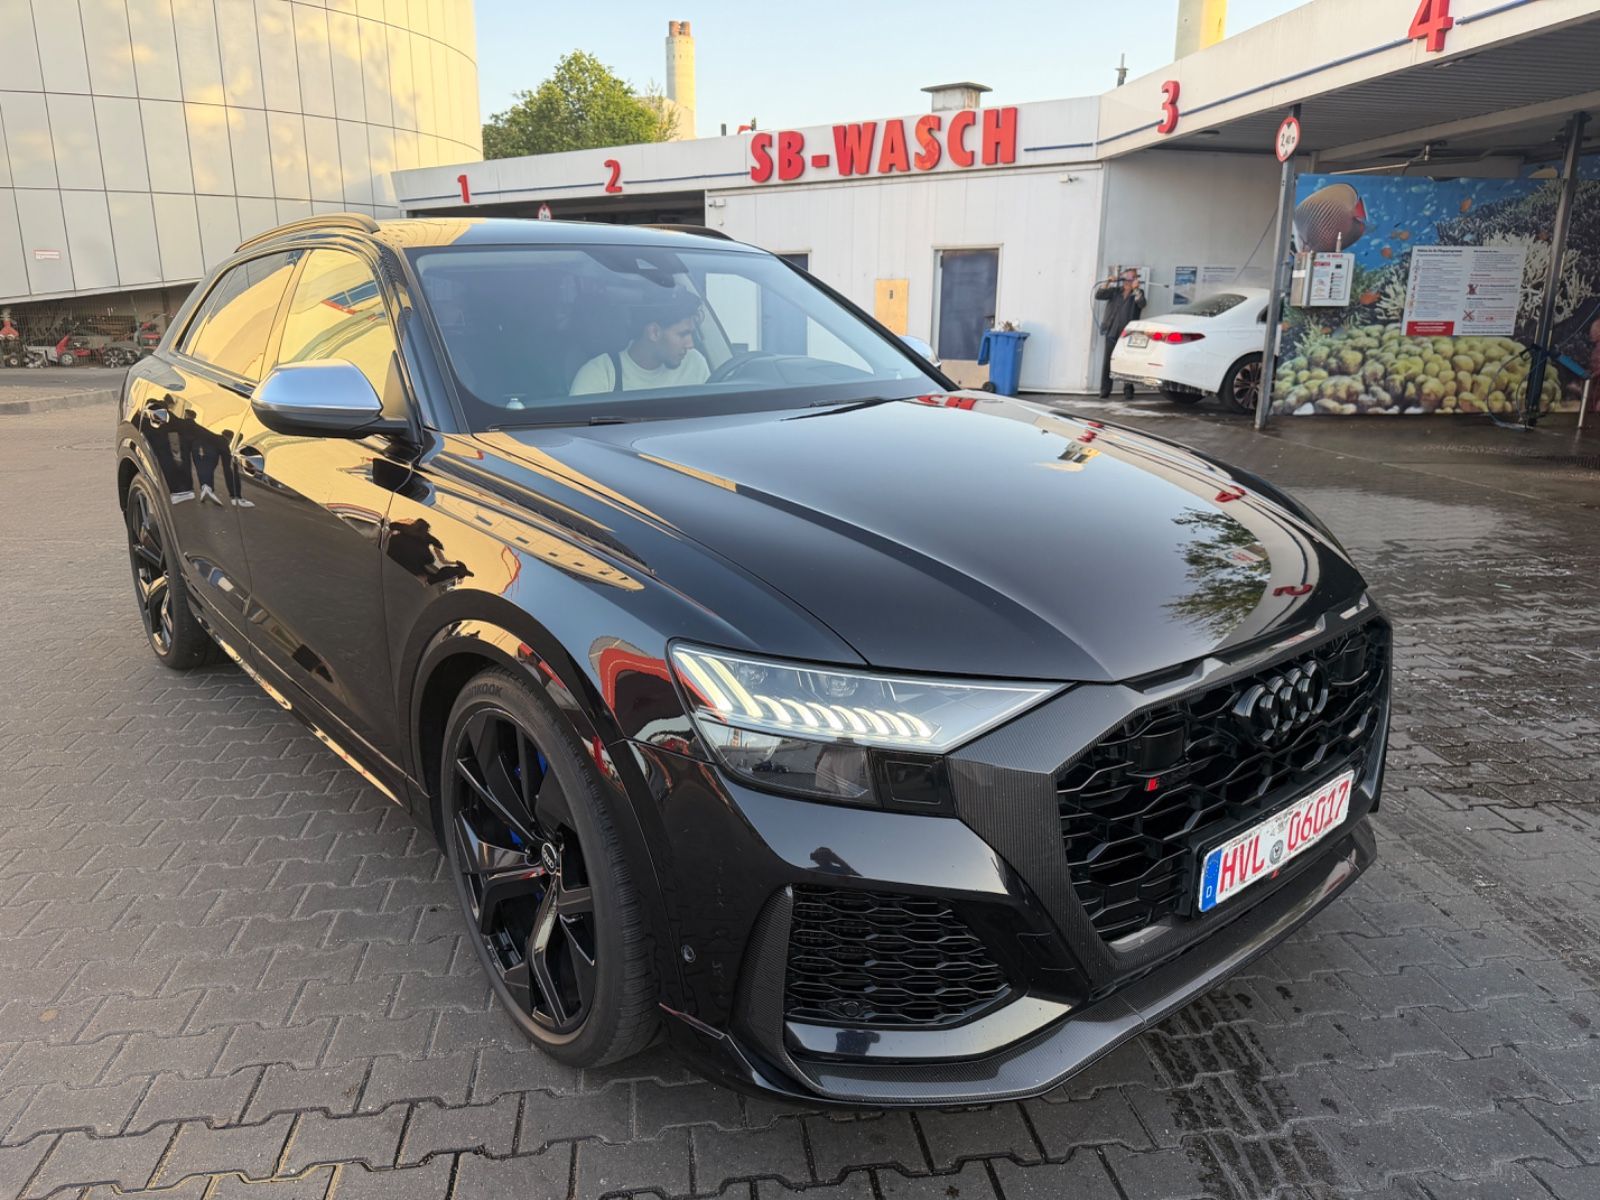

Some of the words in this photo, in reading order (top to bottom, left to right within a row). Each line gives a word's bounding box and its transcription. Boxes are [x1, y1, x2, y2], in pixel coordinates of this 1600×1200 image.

[1408, 0, 1453, 52] 4
[1157, 80, 1180, 134] 3
[750, 106, 1018, 183] SB-WASCH
[457, 174, 470, 204] 1
[603, 159, 623, 193] 2
[1206, 885, 1212, 898] D
[1219, 835, 1265, 893] HVL
[1287, 780, 1349, 851] 06017
